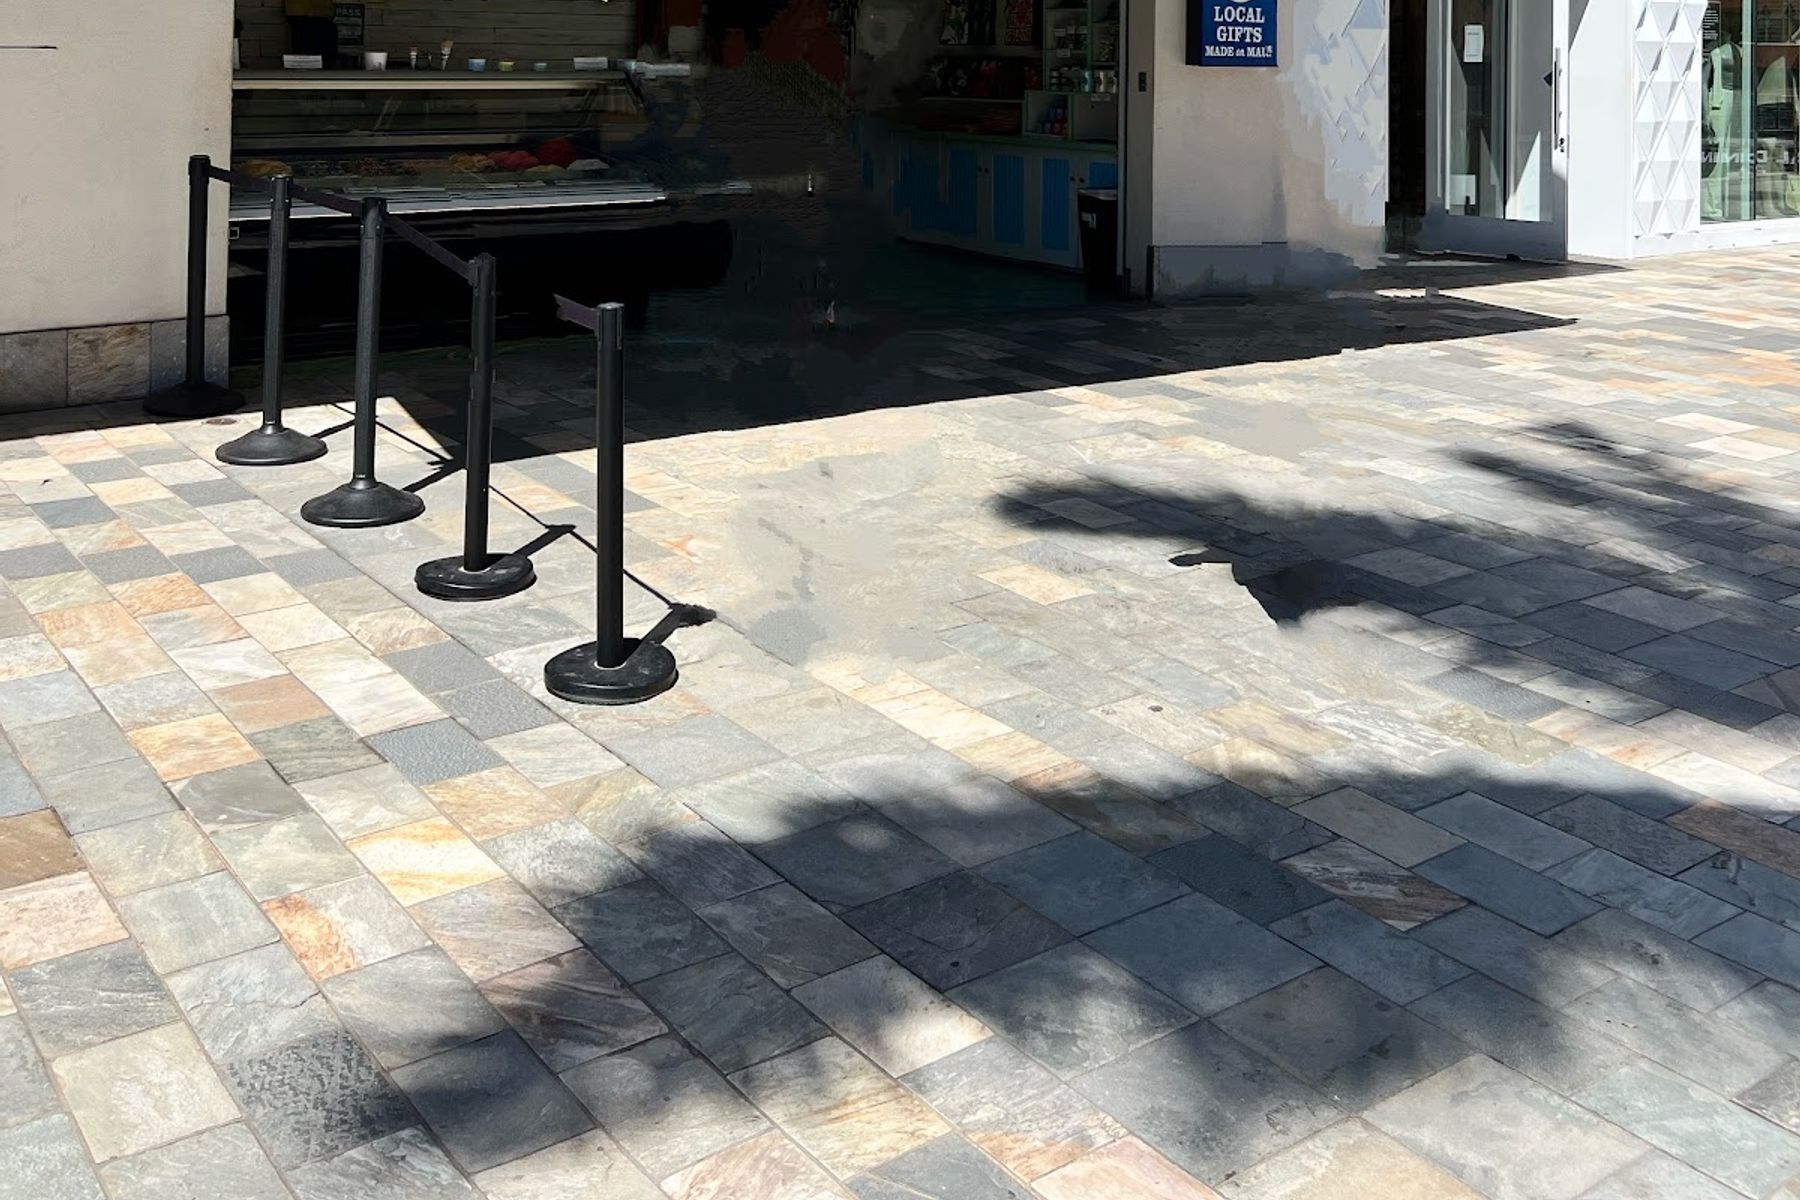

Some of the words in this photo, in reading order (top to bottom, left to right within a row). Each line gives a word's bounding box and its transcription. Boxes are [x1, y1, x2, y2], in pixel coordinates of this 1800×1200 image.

[1214, 5, 1265, 23] LOCAL
[1216, 25, 1263, 43] GIFTS
[1205, 45, 1235, 57] MADE
